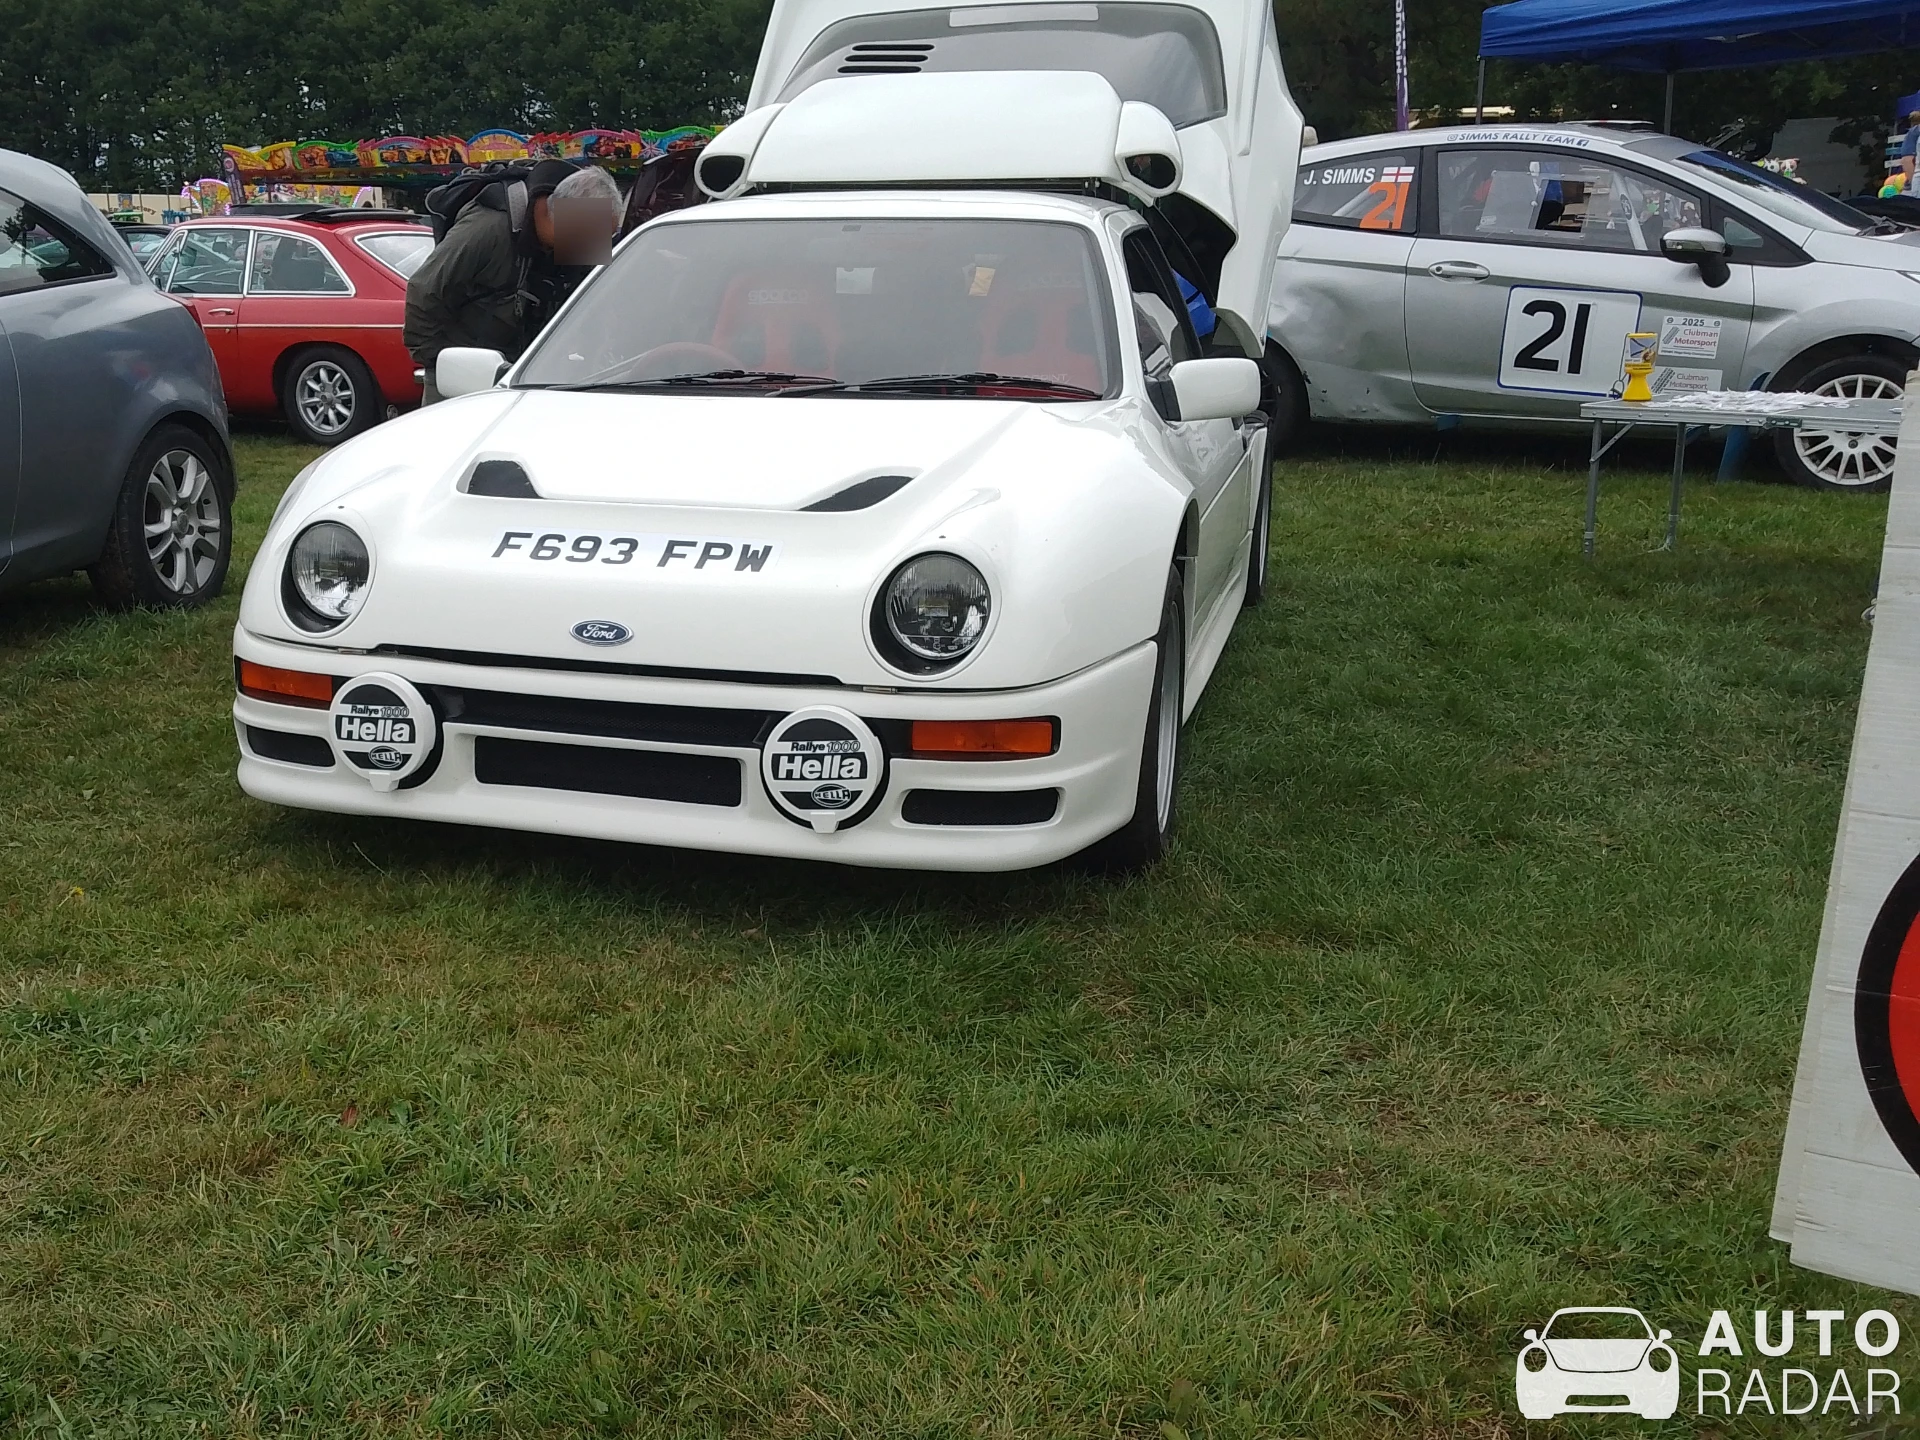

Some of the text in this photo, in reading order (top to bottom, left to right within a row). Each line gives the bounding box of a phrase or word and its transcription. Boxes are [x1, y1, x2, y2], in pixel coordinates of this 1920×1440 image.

[1459, 131, 1576, 146] SIMMS RALLY TEAM
[1303, 167, 1376, 185] J. SIMMS
[132, 205, 157, 215] actory
[1359, 181, 1411, 230] 21
[1681, 317, 1706, 327] 2025
[1513, 299, 1592, 374] 21
[1683, 329, 1719, 338] Clubman
[1674, 337, 1718, 347] Motorsport
[1676, 373, 1709, 381] Clubman
[1669, 381, 1708, 390] Motorsport
[491, 531, 774, 573] F693 FPW
[582, 623, 617, 640] Ford
[350, 704, 410, 718] Rallye 1000
[341, 717, 411, 742] Hella
[791, 741, 861, 753] Rallye 1000
[371, 752, 402, 762] HELLA
[778, 754, 862, 780] Hella
[815, 789, 851, 800] HELLA
